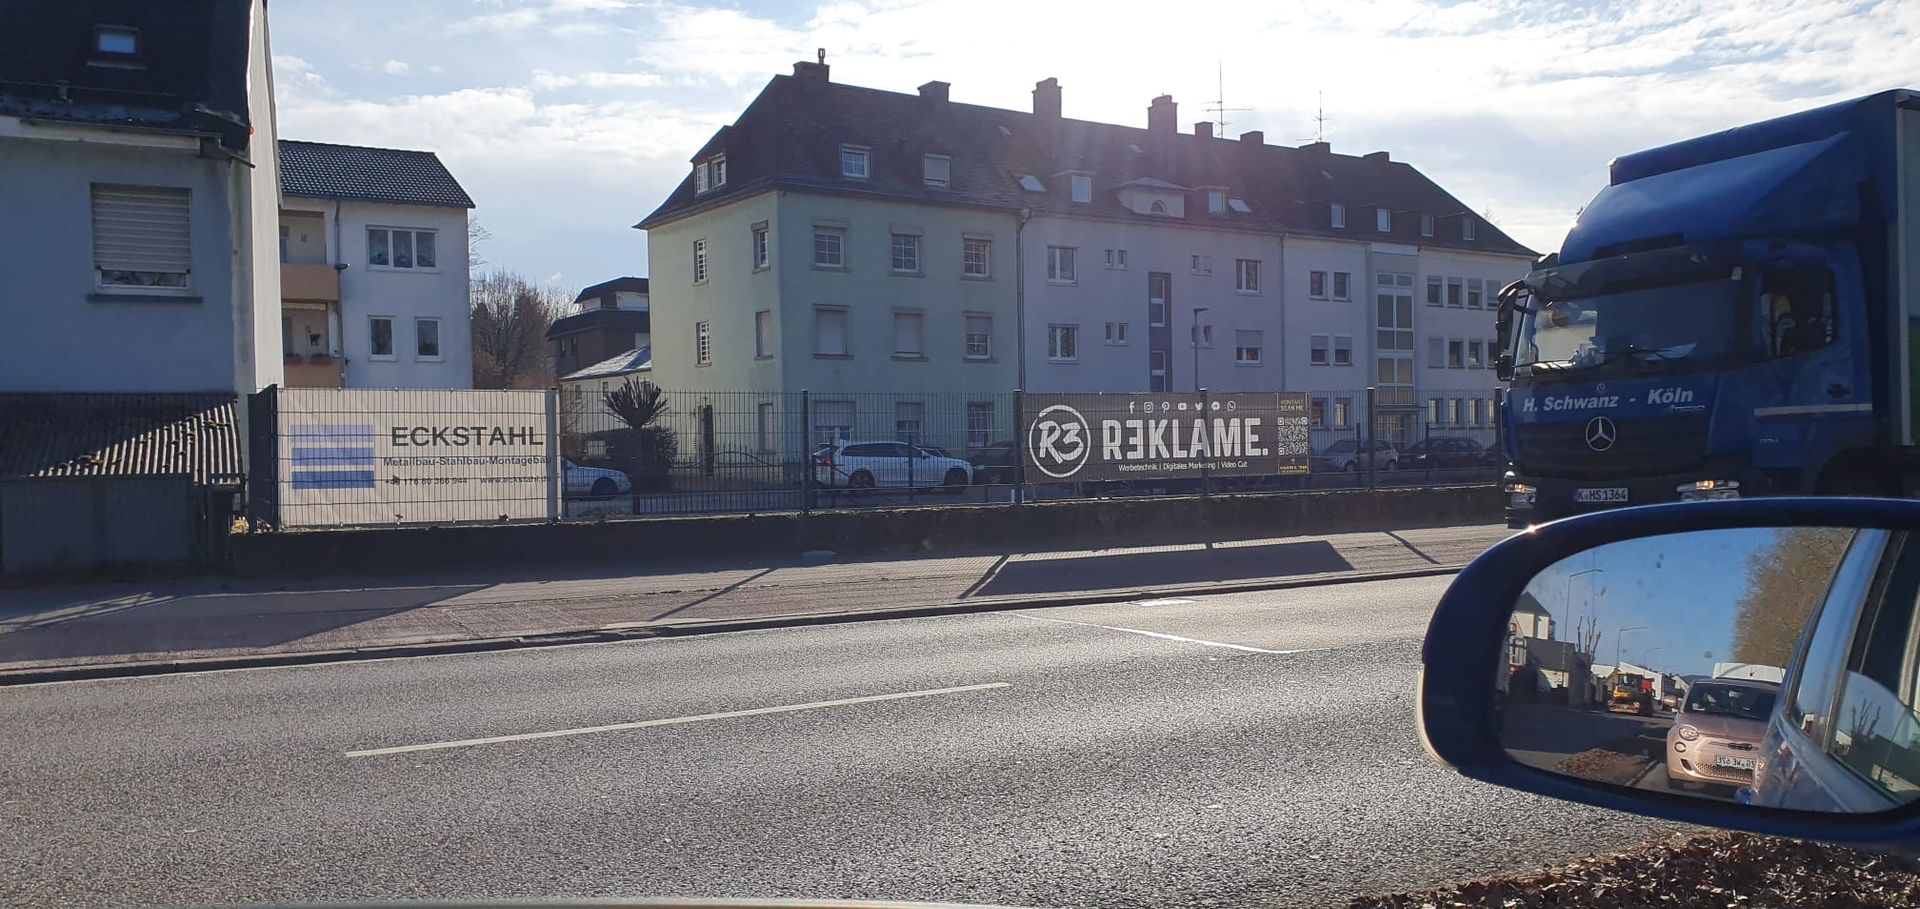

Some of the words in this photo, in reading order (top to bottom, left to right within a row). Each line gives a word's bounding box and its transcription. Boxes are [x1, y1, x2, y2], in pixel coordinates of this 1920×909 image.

[1523, 398, 1538, 412] H.
[1543, 394, 1620, 411] Schwanz
[1647, 387, 1694, 405] Köln
[391, 426, 544, 447] ECKSTAHL
[1038, 420, 1084, 464] R3
[1118, 463, 1158, 472] Werbetechnik
[1163, 462, 1188, 471] Digitales
[1188, 462, 1215, 471] Marketing
[1221, 461, 1237, 469] Video
[1237, 460, 1248, 468] Cut
[480, 475, 549, 484] www.eckstahl.d
